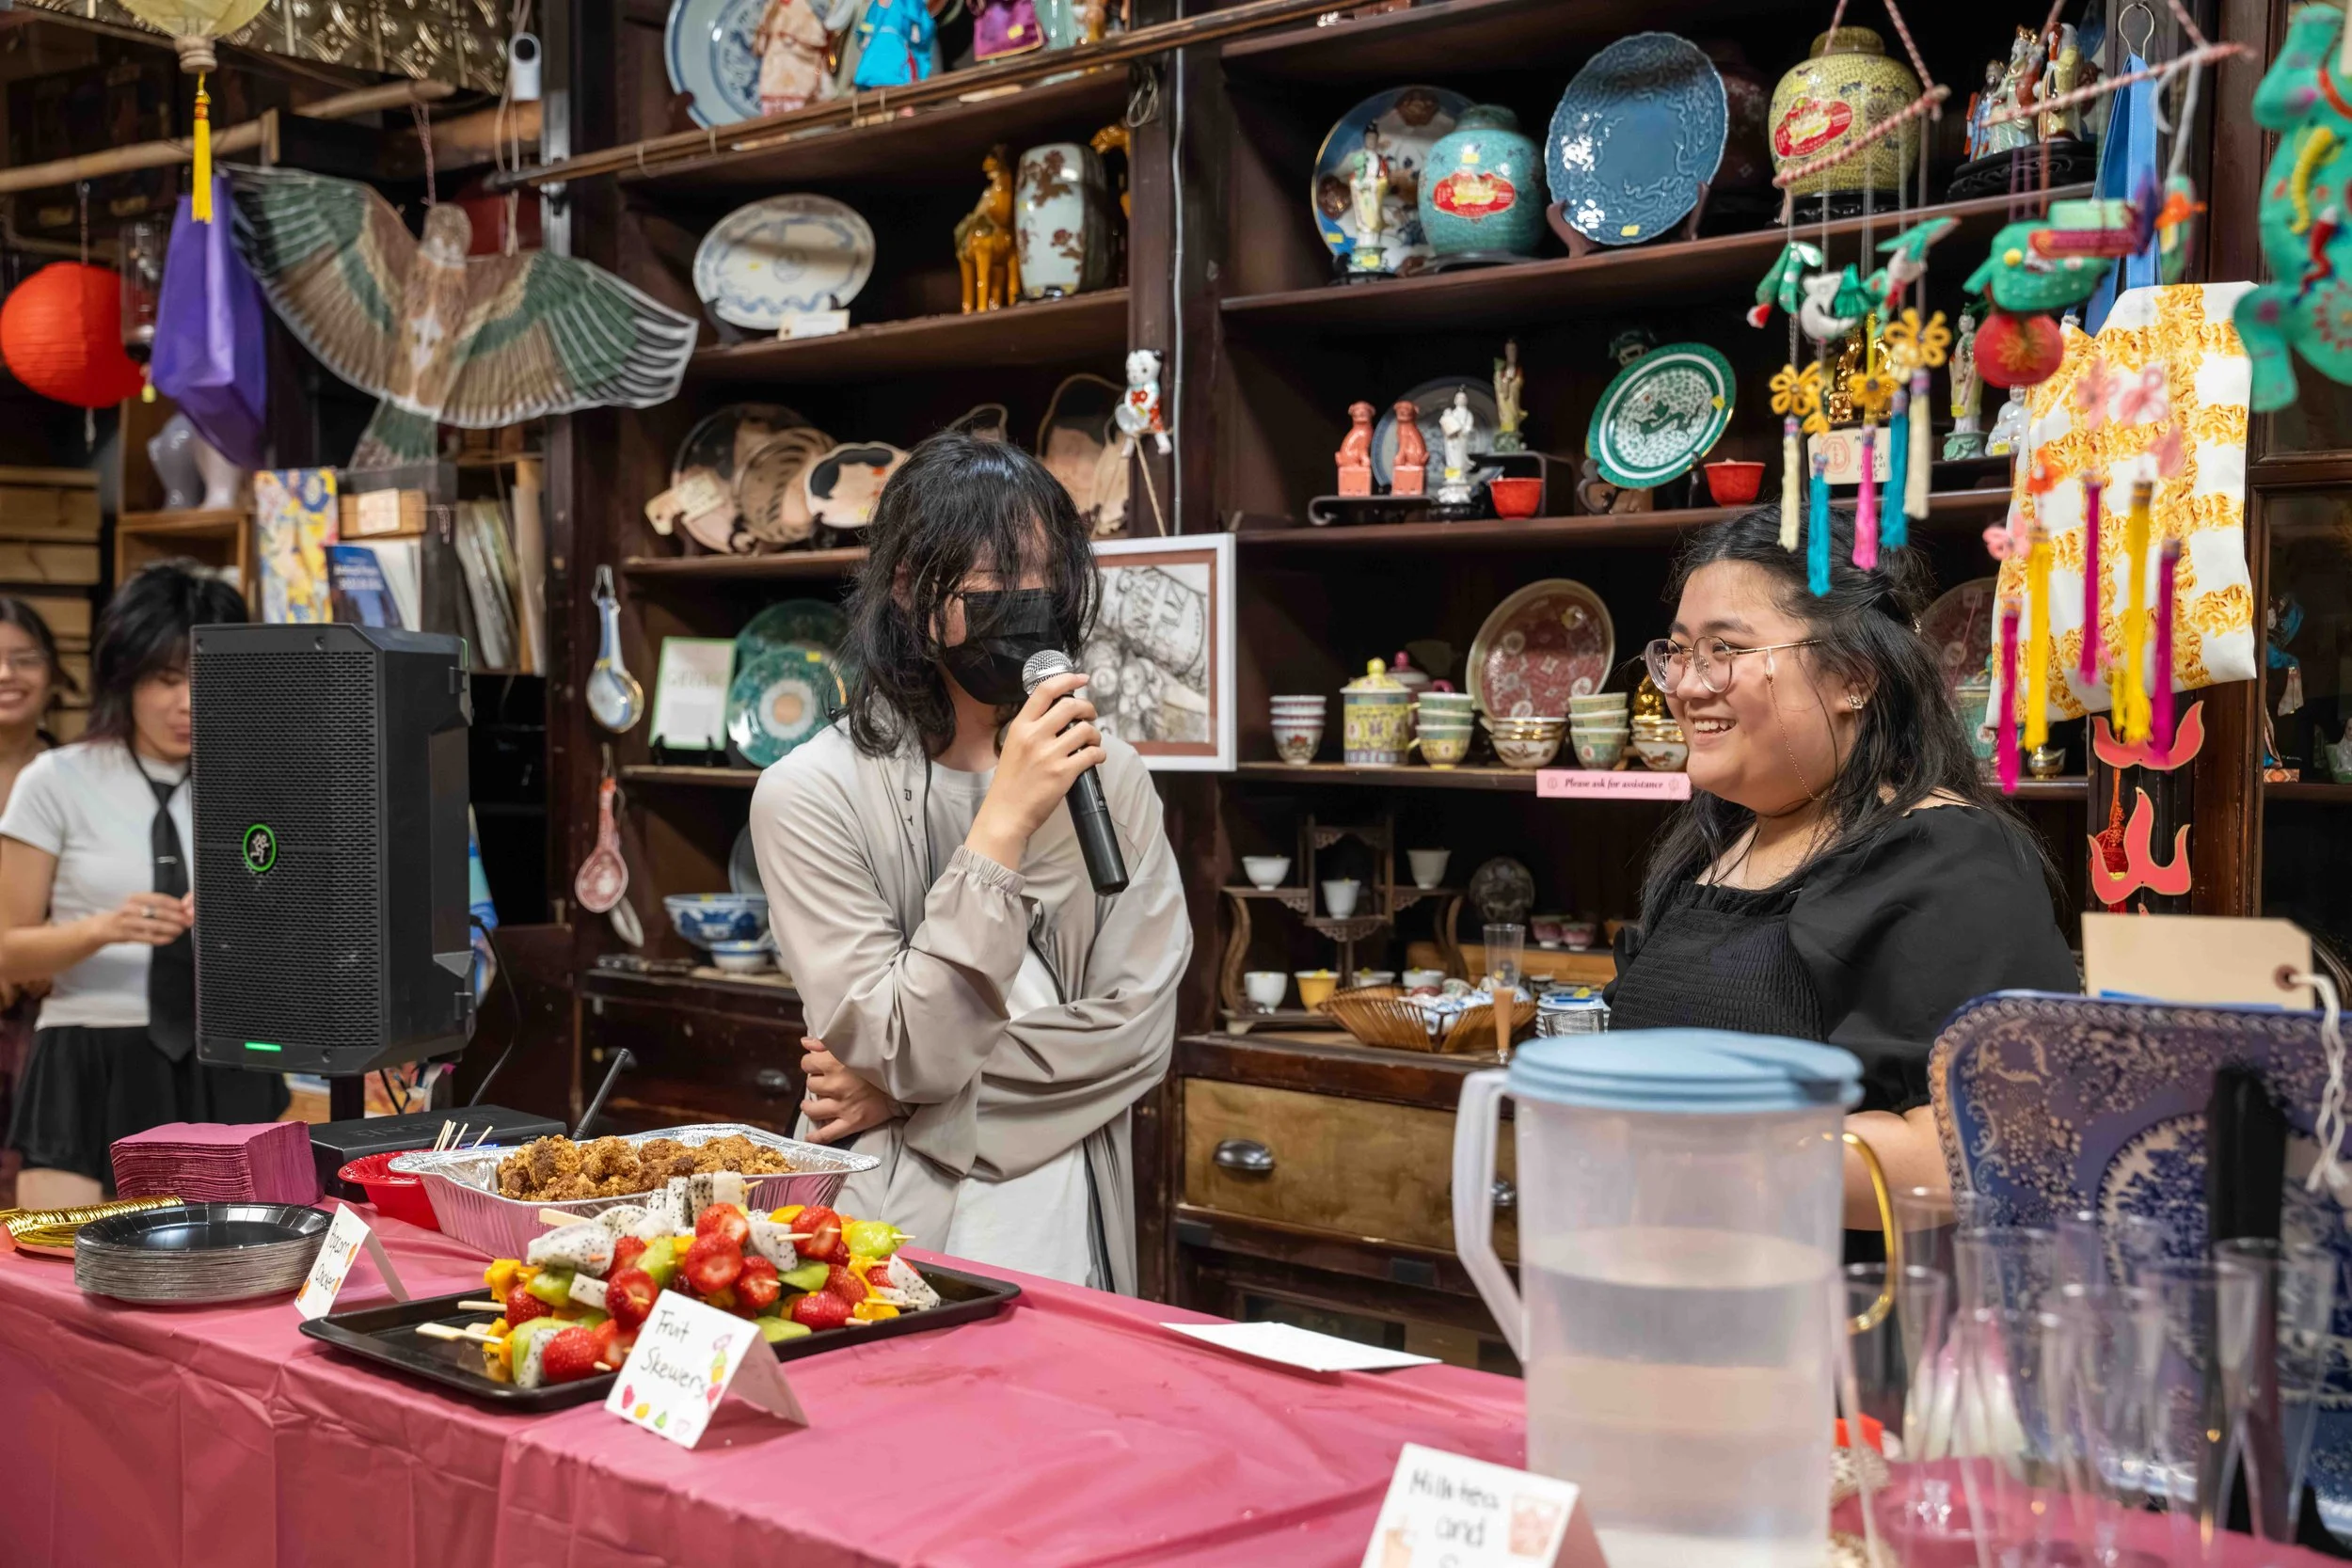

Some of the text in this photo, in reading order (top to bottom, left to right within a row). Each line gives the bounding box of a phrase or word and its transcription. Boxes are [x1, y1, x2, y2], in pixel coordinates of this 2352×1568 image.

[1565, 778, 1663, 790] Please ask for assistance
[655, 1309, 690, 1344] Fruit
[640, 1346, 707, 1399] Skewers
[1435, 1515, 1487, 1549] and
